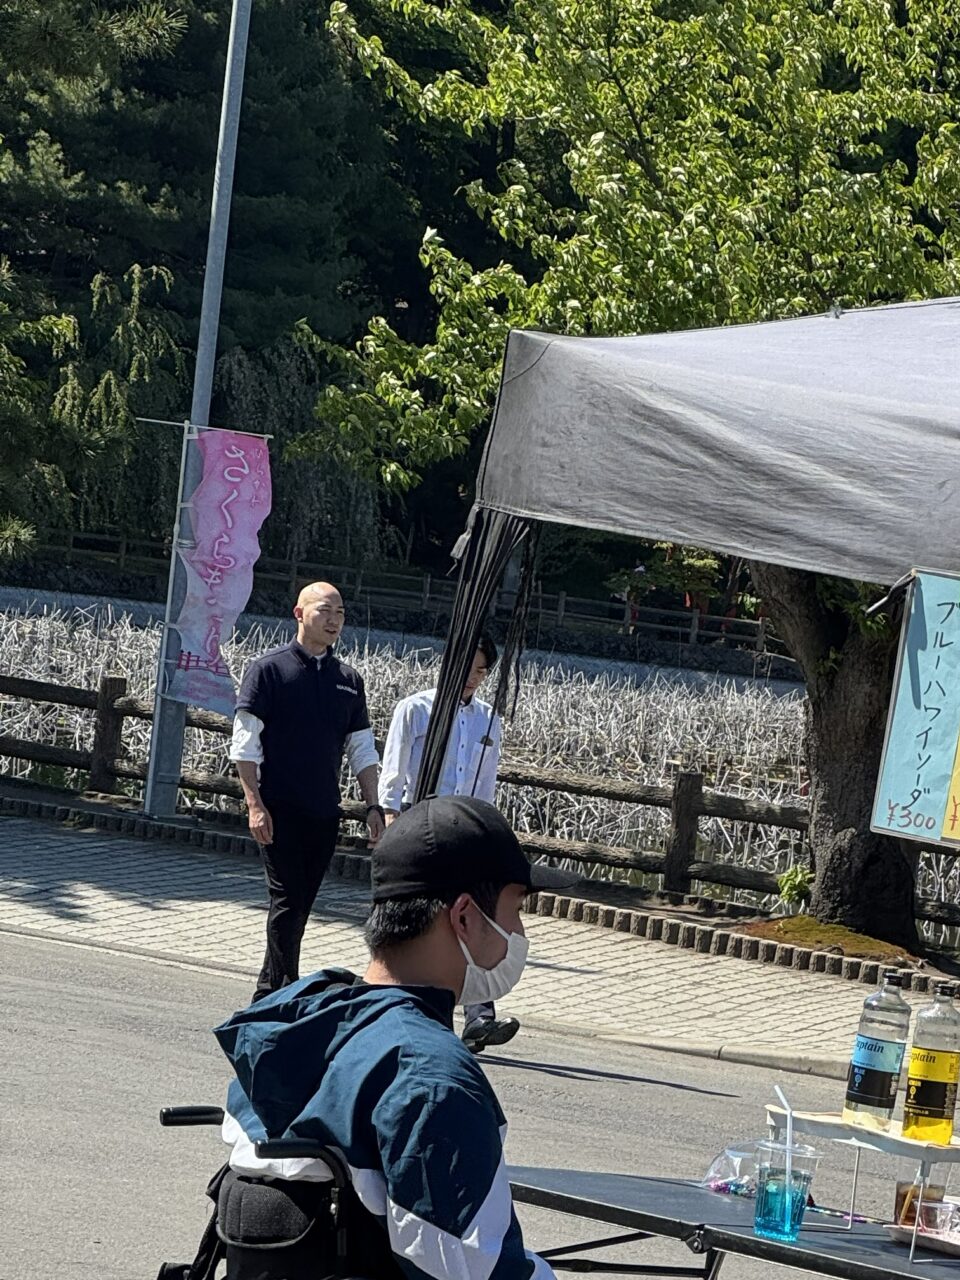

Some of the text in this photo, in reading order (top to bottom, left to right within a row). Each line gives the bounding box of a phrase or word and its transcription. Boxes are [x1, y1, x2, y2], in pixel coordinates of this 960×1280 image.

[902, 601, 960, 809] ブルーハワイソーダ
[887, 799, 936, 830] ¥300
[856, 1036, 885, 1054] aptain
